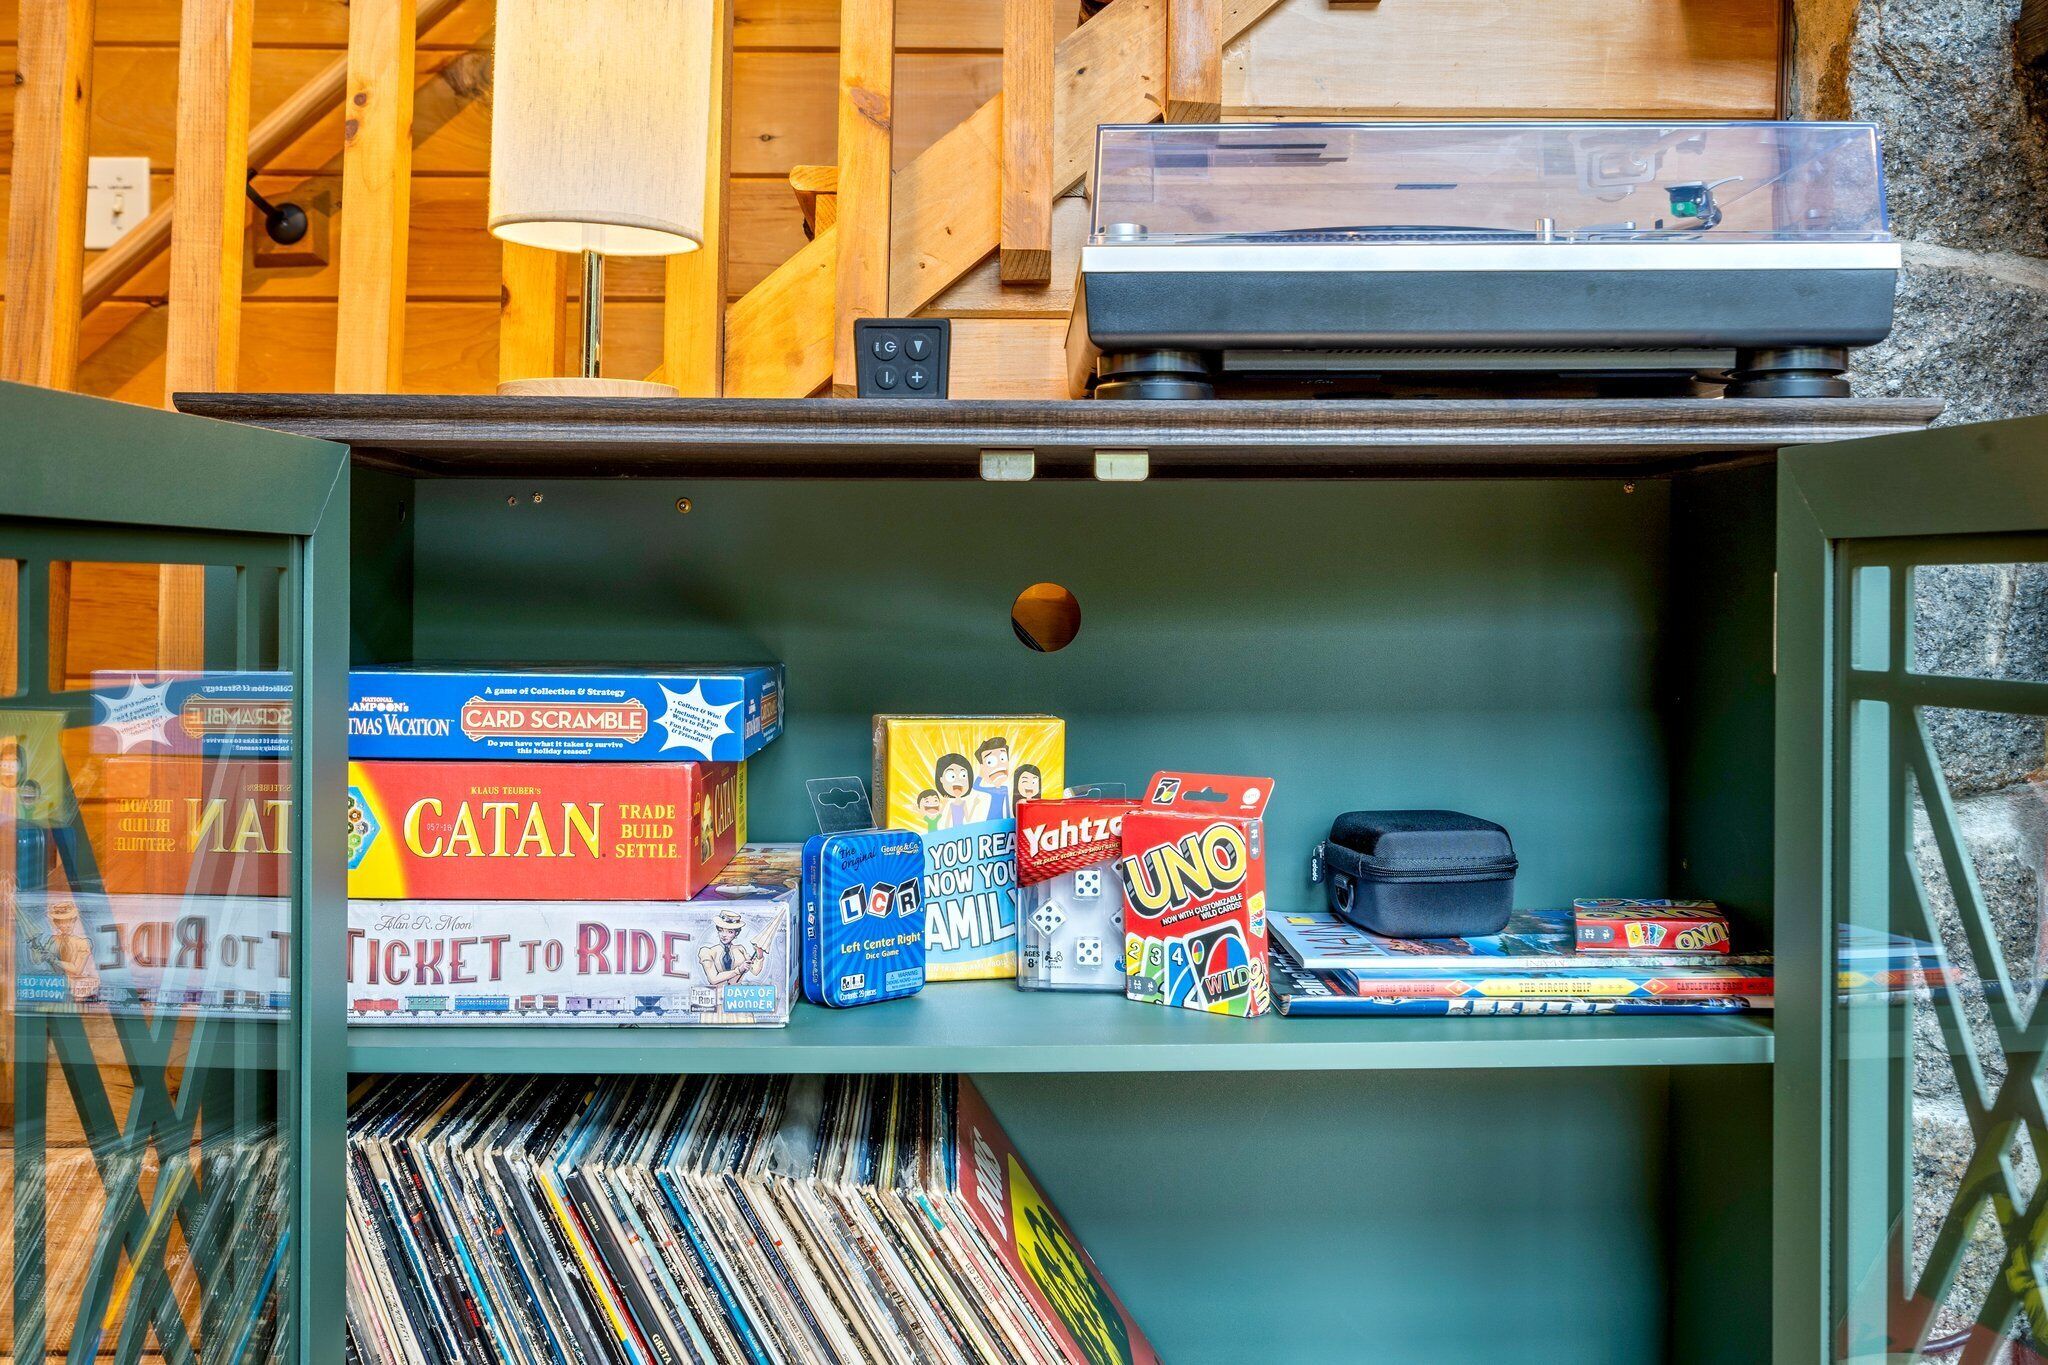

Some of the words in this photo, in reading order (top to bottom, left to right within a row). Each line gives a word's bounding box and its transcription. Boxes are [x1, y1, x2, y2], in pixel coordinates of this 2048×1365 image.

[494, 688, 517, 696] game
[530, 688, 576, 696] Collection
[587, 688, 625, 697] Strategy
[466, 710, 525, 728] CARD
[531, 710, 643, 730] SCRAMBLE
[674, 708, 700, 721] Includes
[706, 719, 719, 727] Fun
[677, 701, 699, 712] Collect
[707, 711, 722, 720] Win!
[384, 714, 450, 736] VACATION
[669, 721, 681, 729] Fun
[682, 724, 692, 732] for
[693, 729, 714, 741] Family
[672, 713, 688, 723] Ways
[697, 721, 712, 731] Play!
[678, 730, 704, 743] Friends!
[471, 787, 499, 795] KLAUS
[619, 804, 676, 819] TRADE
[403, 797, 604, 859] CATAN
[620, 824, 674, 839] BUILD
[615, 843, 678, 859] SETTLE
[840, 847, 856, 859] The
[928, 837, 972, 870] YOU
[1123, 823, 1247, 914] UNO
[1162, 915, 1177, 925] NOW
[1179, 910, 1194, 919] WITH
[1194, 893, 1243, 914] CUSTOMIZABLE
[1200, 909, 1217, 919] WILD
[1218, 902, 1242, 914] CARDS!
[374, 913, 409, 931] Alan
[412, 915, 433, 930] R.
[435, 914, 473, 931] Moon
[841, 942, 860, 954] Left
[864, 937, 895, 950] Center
[897, 932, 921, 945] Right
[1675, 922, 1729, 950] UNO
[519, 938, 563, 975] TO
[575, 920, 691, 979] RIDE
[865, 952, 880, 960] Dice
[881, 949, 899, 957] Game
[1128, 942, 1140, 960] 2
[1150, 947, 1161, 966] 3
[1172, 947, 1183, 966] 4
[1028, 958, 1038, 968] 8+
[1205, 967, 1250, 996] WILD
[1250, 957, 1270, 1014] UNO
[1519, 982, 1536, 993] THE
[1539, 982, 1570, 993] CIRCUS
[1573, 982, 1592, 993] SHIP
[727, 988, 755, 998] DAYS
[757, 988, 773, 998] OF
[726, 1000, 773, 1009] WONDER
[354, 1155, 366, 1176] CHOICE
[362, 1176, 373, 1194] LOCAL
[369, 1193, 380, 1209] CUTS
[400, 1161, 414, 1186] ATLANTIC
[362, 1197, 372, 1213] JEFF
[537, 1209, 546, 1222] THE
[542, 1221, 557, 1245] BEATLES
[735, 1191, 747, 1206] WAY
[786, 1280, 800, 1297] NASH
[801, 1305, 816, 1326] YOUNG
[680, 1237, 693, 1256] WILLIE
[689, 1255, 705, 1278] NELSON
[707, 1287, 726, 1316] STARDUST
[965, 1263, 976, 1275] LED
[699, 1243, 715, 1267] DYLAN'S
[712, 1267, 730, 1294] GREATEST
[727, 1294, 738, 1309] HITS
[745, 1329, 761, 1353] VOLUME
[651, 1333, 673, 1365] GRETA
[797, 1333, 811, 1352] TAYLOR
[477, 1346, 489, 1365] JACKET
